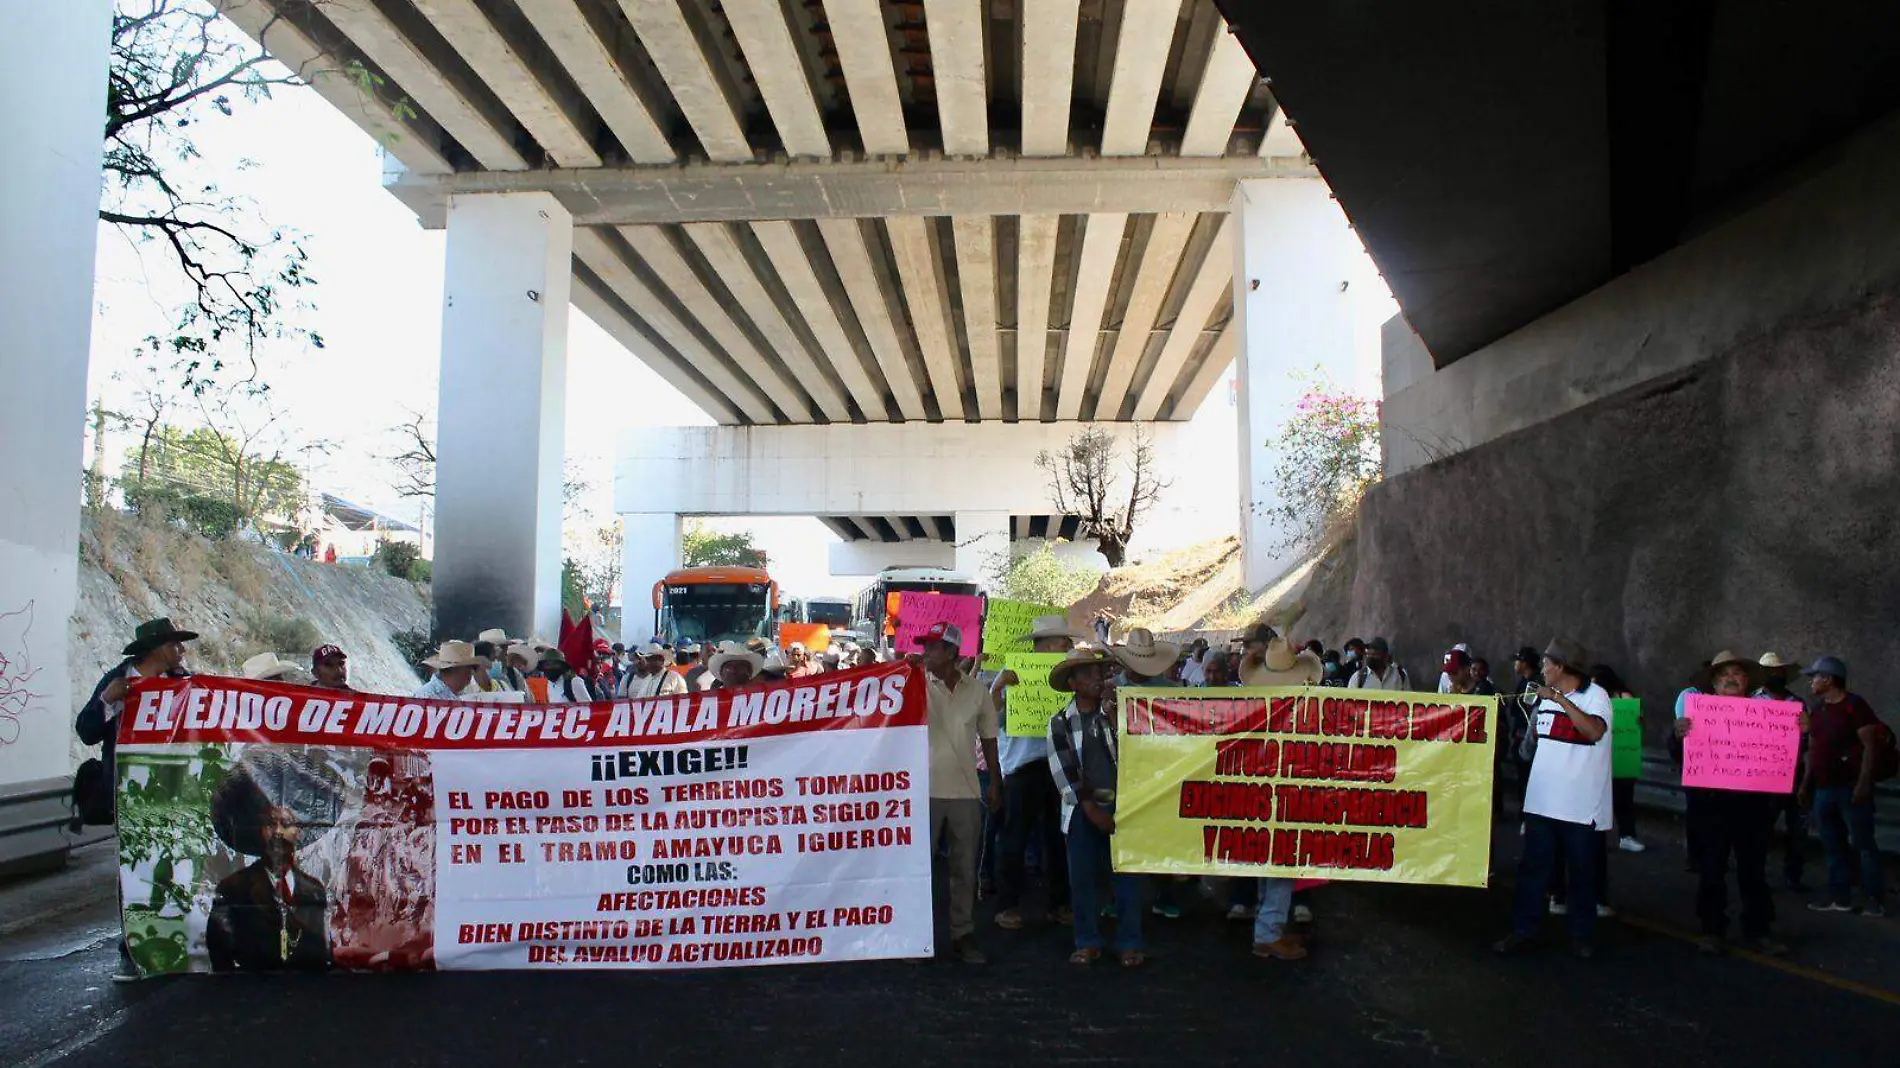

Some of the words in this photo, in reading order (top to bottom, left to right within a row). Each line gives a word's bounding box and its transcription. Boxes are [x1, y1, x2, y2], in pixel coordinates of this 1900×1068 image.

[133, 691, 174, 730] EL
[183, 689, 292, 730] EJIDO
[298, 699, 353, 733] DE
[354, 702, 597, 742] MOYOTEPEC,
[603, 696, 719, 737] AYALA
[727, 675, 906, 728] MORELOS
[1125, 697, 1152, 735] LA
[1269, 696, 1295, 733] DE
[1297, 697, 1320, 735] LA
[1322, 697, 1369, 739] SICT
[1370, 699, 1410, 740] NOS
[1467, 705, 1488, 743] EL
[1215, 739, 1280, 777] TITULO
[1281, 741, 1397, 783] PARCELARIO
[449, 792, 472, 809] EL
[484, 788, 550, 810] PAGO
[563, 790, 593, 808] DE
[605, 787, 649, 805] LOS
[661, 778, 783, 802] TERRENOS
[796, 772, 910, 795] TOMADOS
[1179, 780, 1272, 822] EXIGIMOS
[1274, 783, 1427, 828] TRANSPARENCIA
[450, 815, 499, 836] POR
[505, 815, 529, 834] EL
[537, 814, 598, 833] PASO
[606, 813, 635, 831] DE
[641, 812, 672, 830] LA
[675, 806, 807, 829] AUTOPISTA
[813, 801, 879, 823] SIGLO
[885, 800, 910, 819] 21
[450, 844, 481, 865] EN
[499, 844, 525, 863] EL
[541, 840, 636, 861] TRAMO
[652, 834, 782, 858] AMAYUCA
[798, 826, 911, 851] IGUERON
[1203, 825, 1219, 863] Y
[1217, 827, 1270, 865] PAGO
[1271, 827, 1299, 867] DE
[1298, 829, 1395, 870] PARCELAS
[627, 863, 689, 884] COMO
[694, 861, 738, 881] LAS:
[597, 886, 766, 911] AFECTACIONES
[459, 923, 512, 944] BIEN
[519, 919, 629, 941] DISTINTO
[634, 919, 663, 937] DE
[669, 918, 695, 935] LA
[702, 912, 781, 934] TIERRA
[787, 912, 803, 930] Y
[805, 910, 828, 929] EL
[833, 905, 892, 926] PAGO
[528, 945, 568, 965] DEL
[574, 941, 660, 963] AVALUO
[665, 936, 822, 961] ACTUALIZADO
